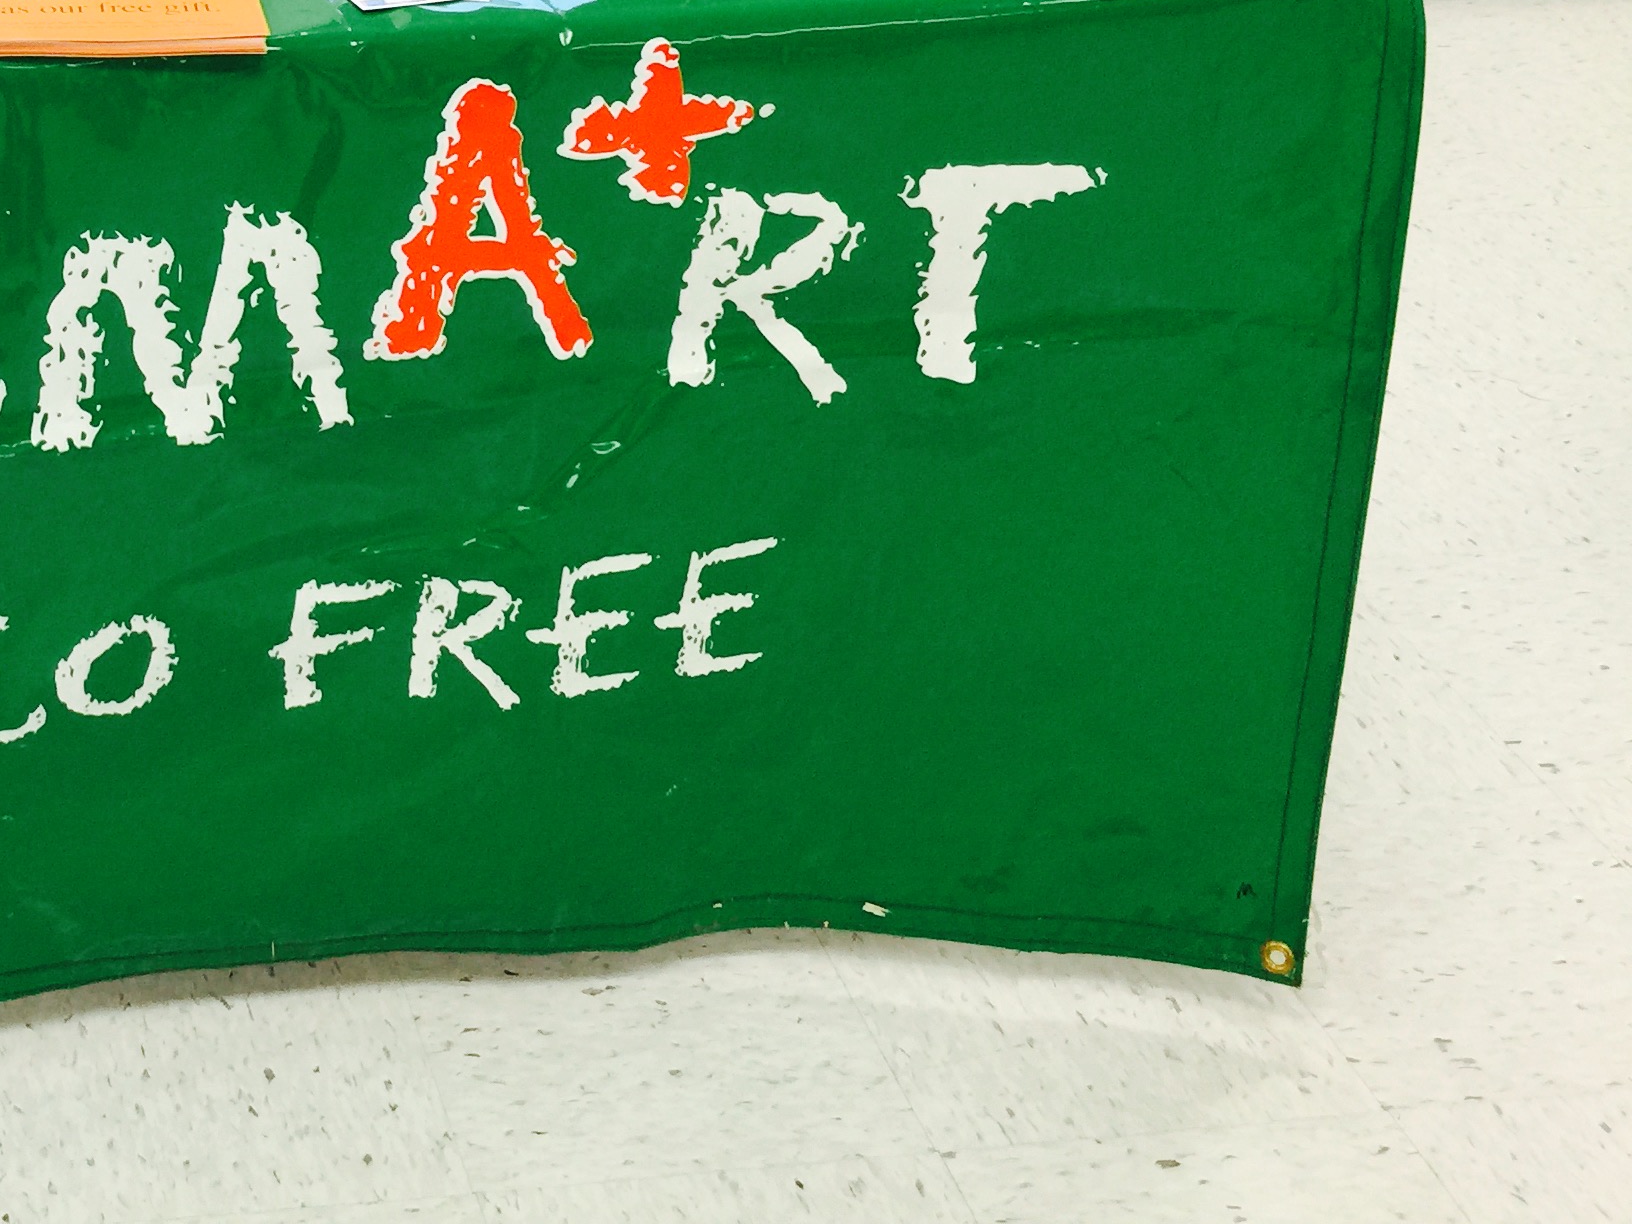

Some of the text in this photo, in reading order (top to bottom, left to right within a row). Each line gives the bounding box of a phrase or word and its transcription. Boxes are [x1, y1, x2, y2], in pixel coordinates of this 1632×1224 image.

[0, 4, 30, 16] as
[39, 3, 89, 15] our
[99, 1, 153, 14] free
[164, 0, 222, 16] gift.
[268, 535, 782, 712] FREE
